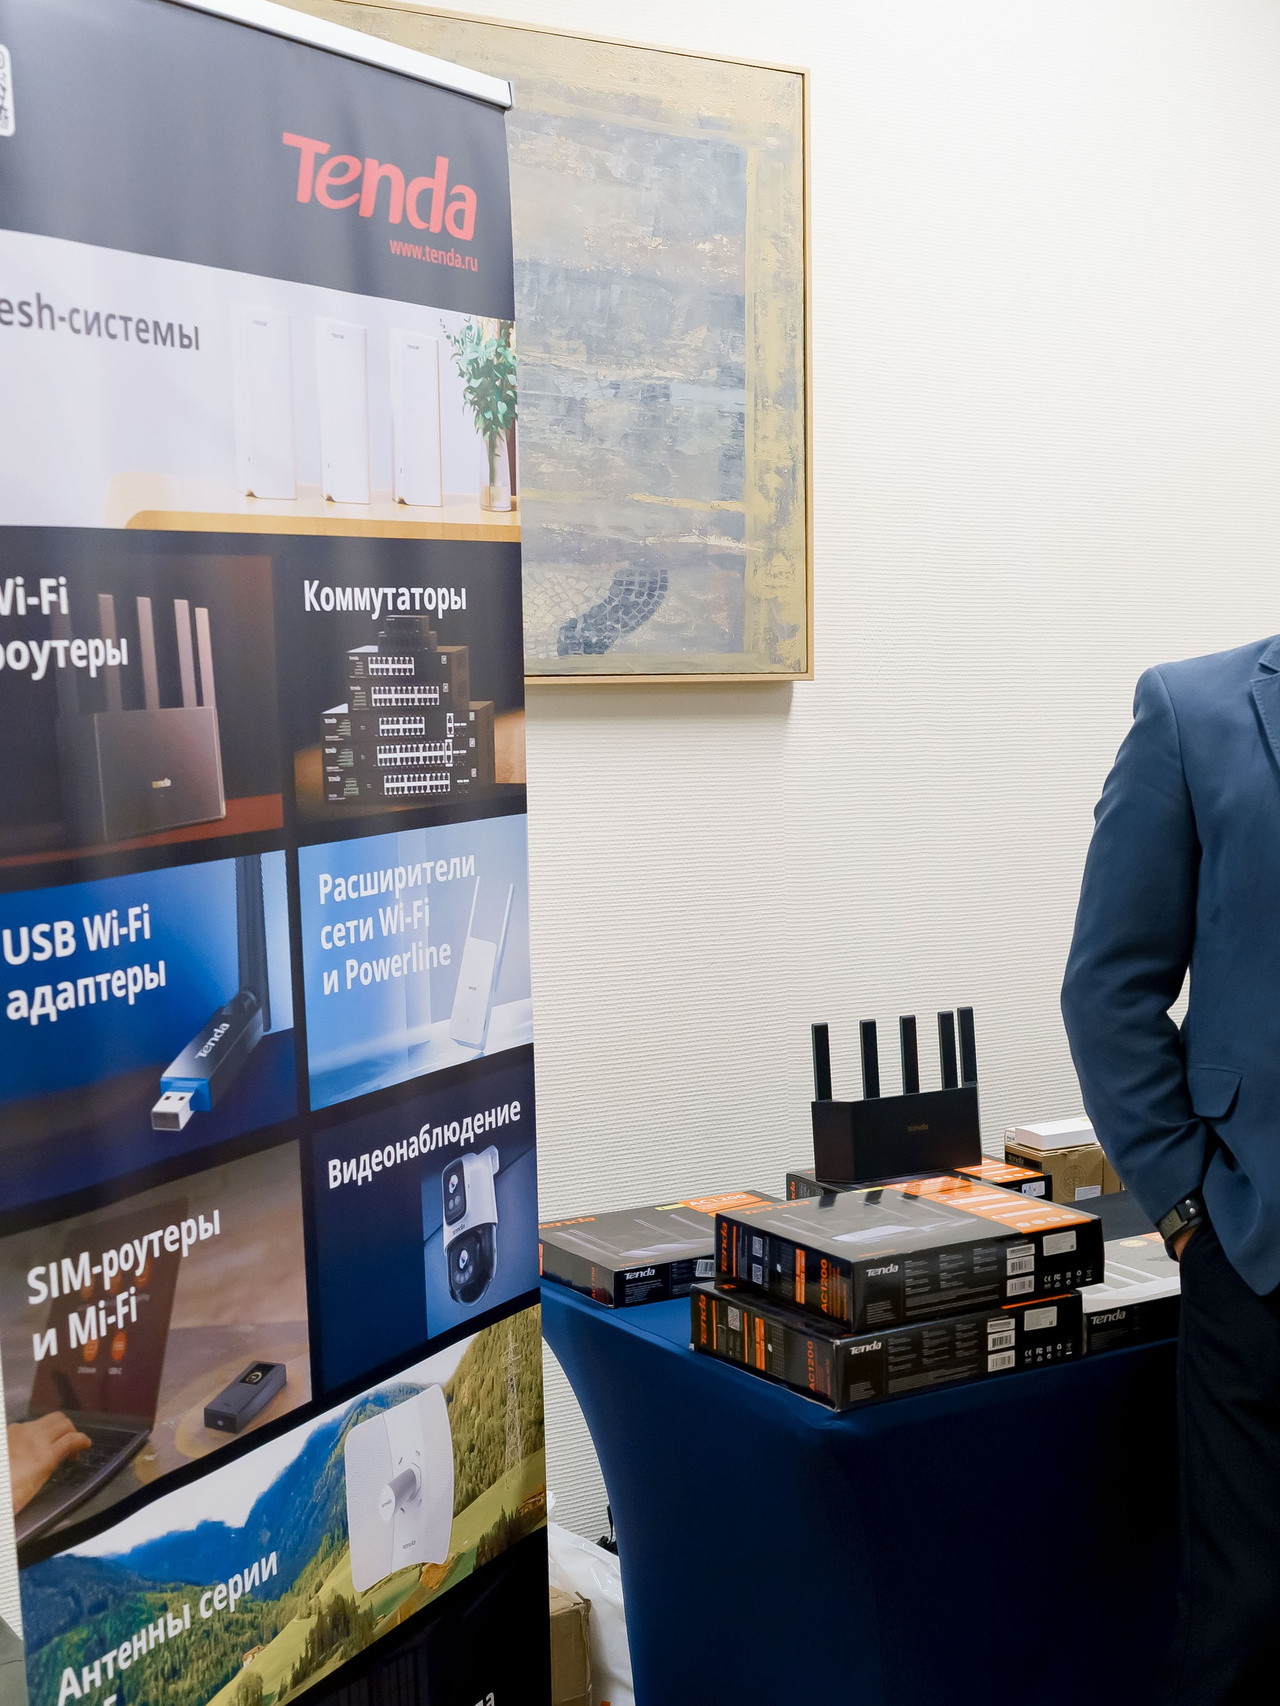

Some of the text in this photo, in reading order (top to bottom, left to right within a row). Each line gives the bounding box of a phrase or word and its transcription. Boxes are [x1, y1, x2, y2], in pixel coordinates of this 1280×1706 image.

[282, 131, 477, 241] Tenda
[389, 239, 478, 272] www.tenda.ru
[0, 293, 200, 351] esh-системы
[303, 579, 468, 620] Коммутаторы
[319, 854, 475, 905] Расширители
[3, 903, 151, 966] USB Wi-Fi
[320, 898, 430, 950] сети Wi-Fi
[6, 958, 167, 1025] адаптеры
[322, 939, 452, 995] и Powerline
[195, 1021, 231, 1060] Tenda
[328, 1099, 521, 1190] Видеонаблюдение
[27, 1207, 221, 1305] SIM-роутеры
[624, 1267, 656, 1280] Tenda
[866, 1263, 899, 1278] Tenda
[820, 1258, 828, 1313] AC1200
[31, 1286, 138, 1362] и Mi-Fi
[699, 1293, 707, 1346] Tenda
[1091, 1308, 1126, 1325] Tenda
[807, 1340, 815, 1392] AC1200
[850, 1340, 882, 1355] Tenda
[57, 1551, 279, 1706] Антенны серии
